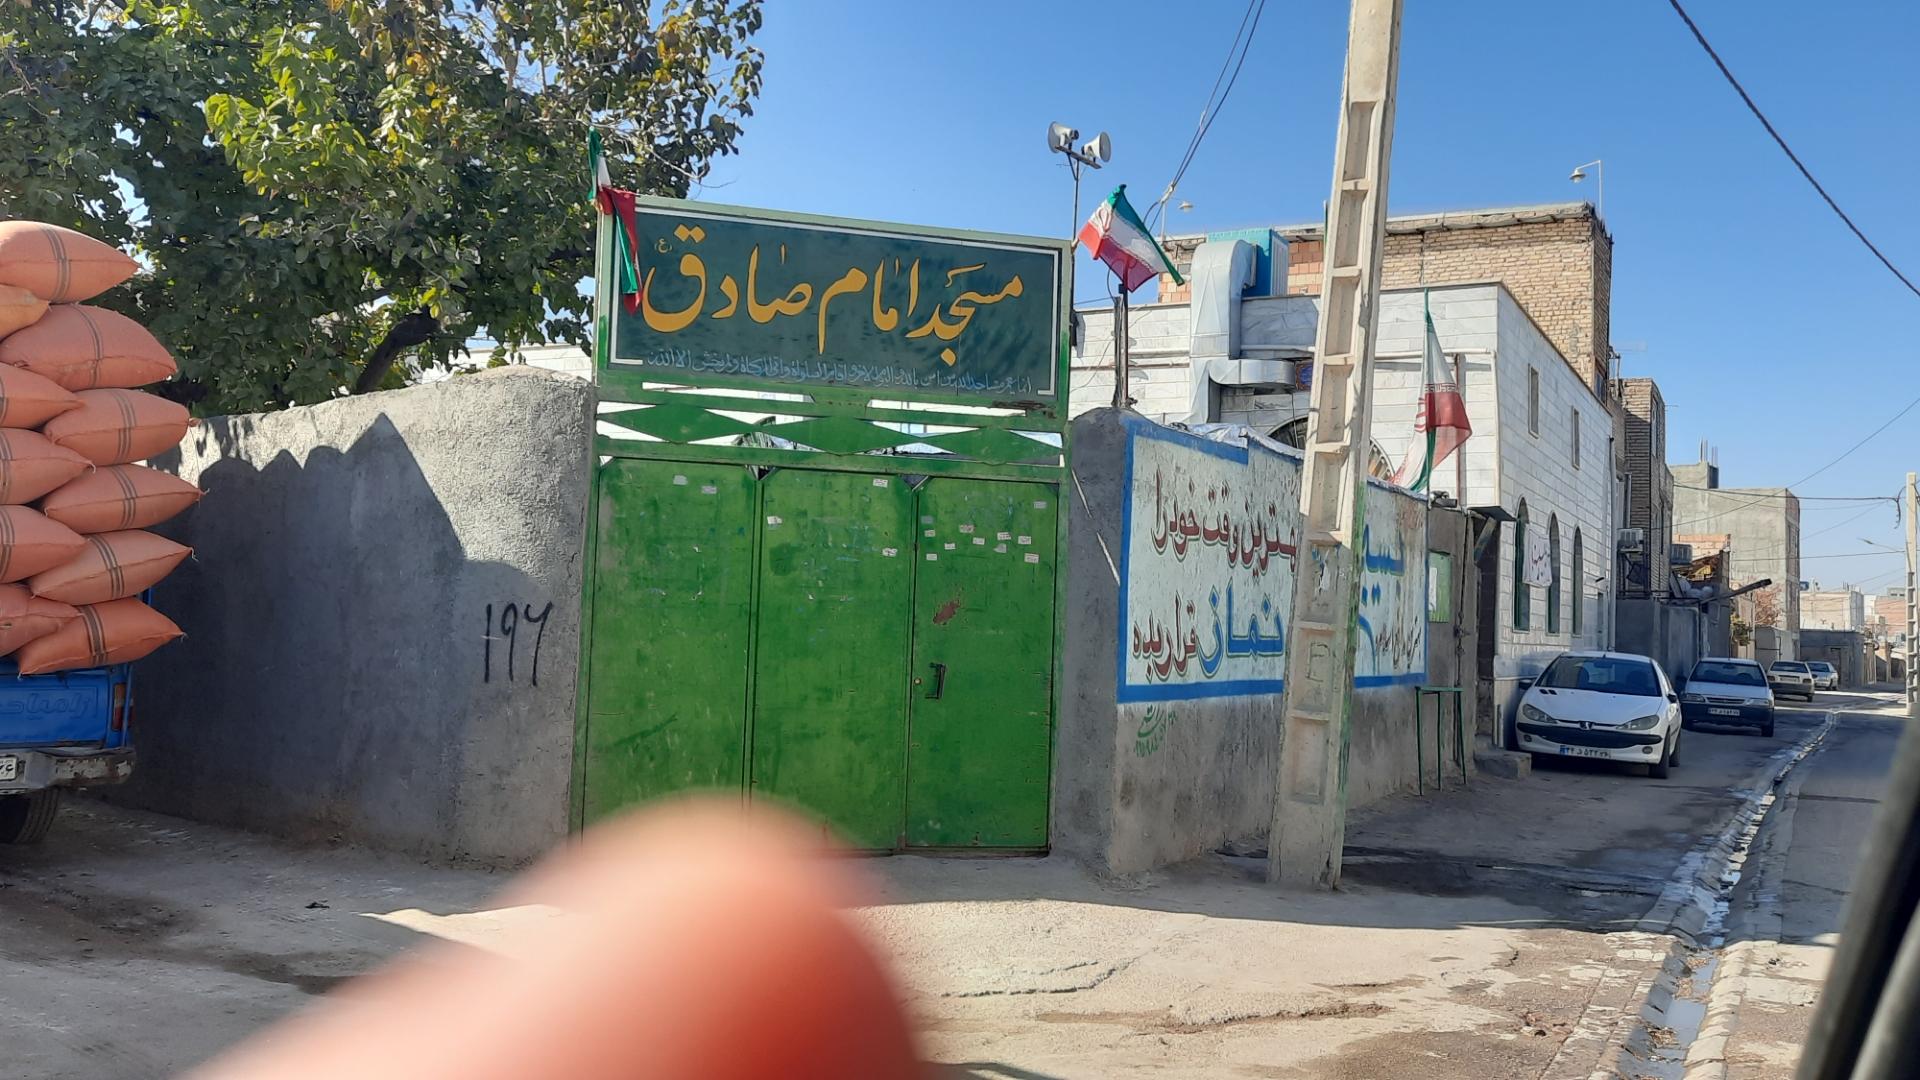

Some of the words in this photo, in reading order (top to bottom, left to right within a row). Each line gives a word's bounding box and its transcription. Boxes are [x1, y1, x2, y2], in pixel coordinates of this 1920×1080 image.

[642, 222, 813, 333] صادق
[819, 255, 920, 355] امام
[905, 262, 1023, 367] مسجد
[1241, 496, 1297, 578] هترین
[1198, 577, 1285, 679] نماز
